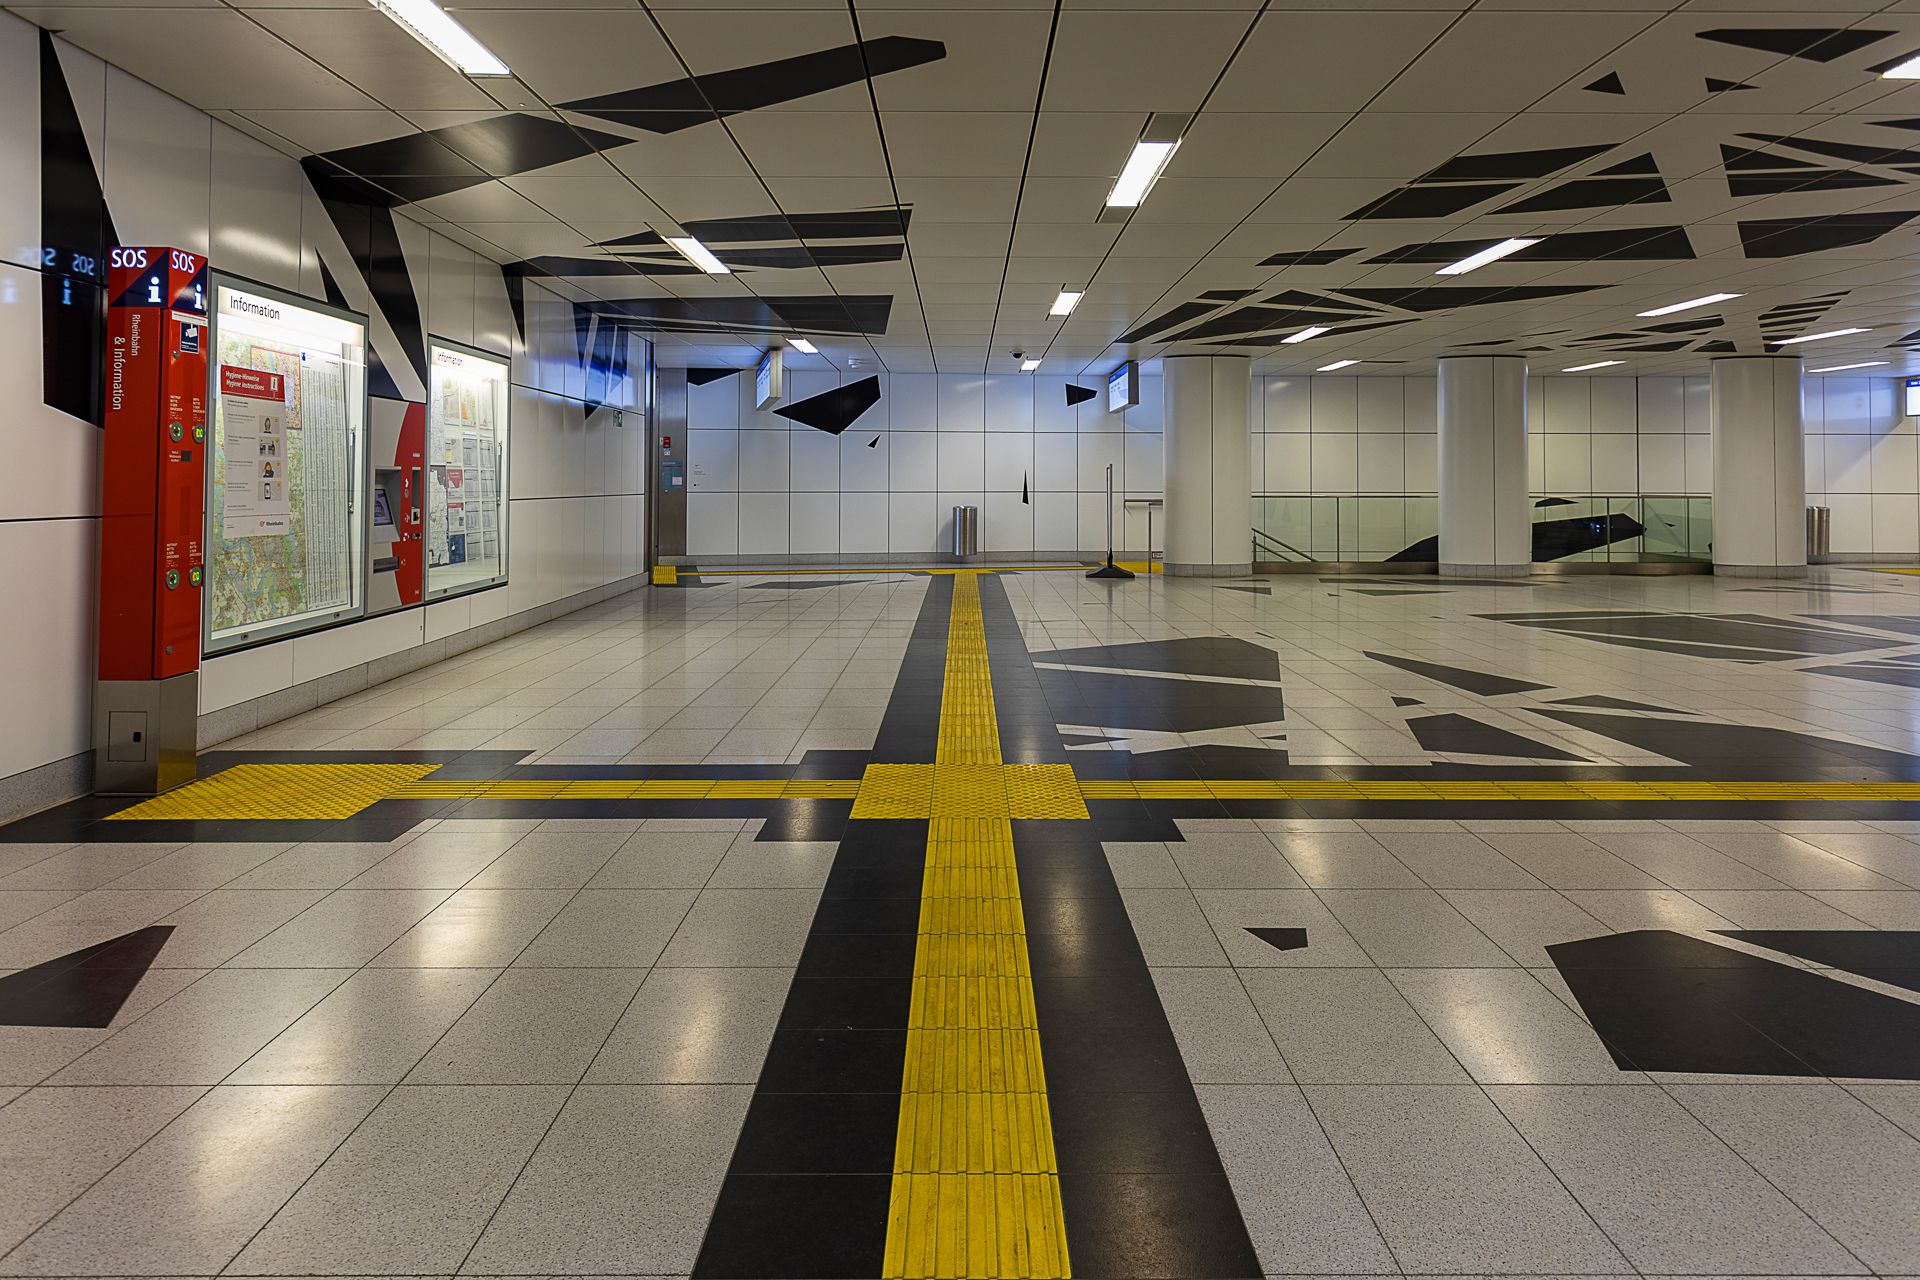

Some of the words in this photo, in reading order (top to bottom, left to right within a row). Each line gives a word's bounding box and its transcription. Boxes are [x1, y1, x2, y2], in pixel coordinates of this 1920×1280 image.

[111, 249, 147, 268] SOS
[172, 251, 195, 273] SOS
[148, 277, 161, 303] i
[194, 284, 203, 309] i
[230, 296, 280, 320] Information
[114, 336, 126, 345] &
[131, 314, 141, 356] Rheinbahn
[437, 351, 464, 367] Information
[112, 348, 126, 410] Information
